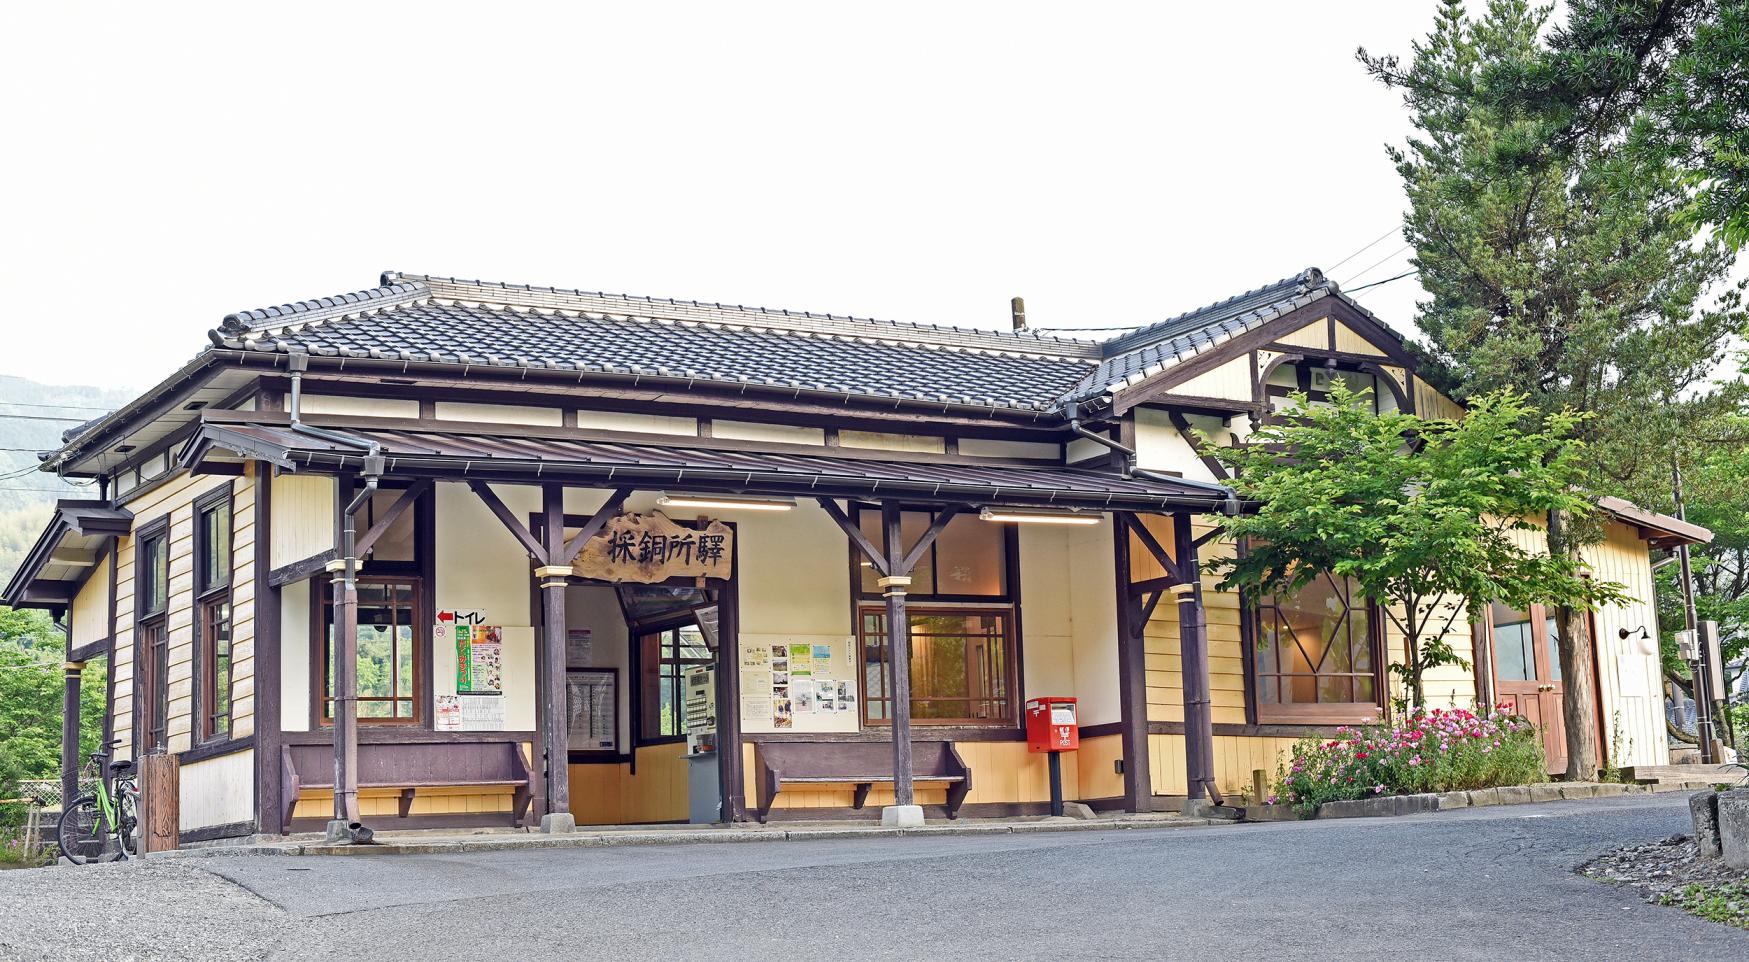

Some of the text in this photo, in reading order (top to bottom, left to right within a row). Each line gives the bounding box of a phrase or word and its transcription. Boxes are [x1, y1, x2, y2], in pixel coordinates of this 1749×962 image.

[607, 529, 725, 567] 採銅所驛
[454, 611, 485, 625] トイレ
